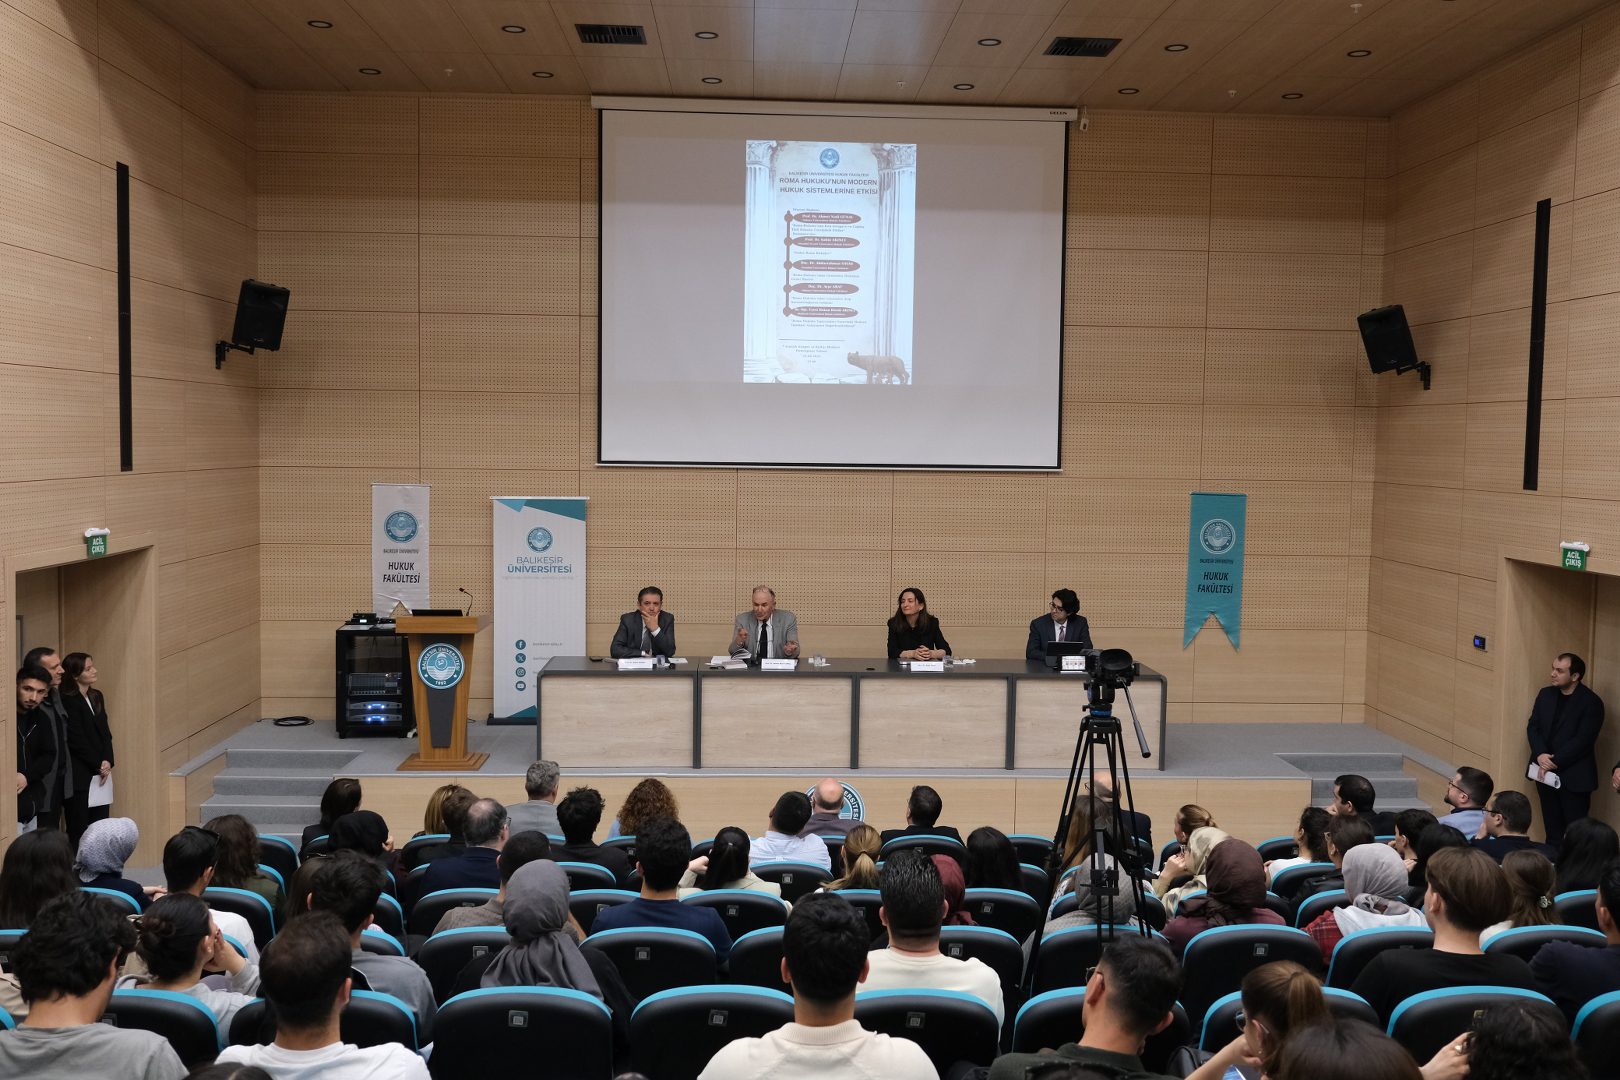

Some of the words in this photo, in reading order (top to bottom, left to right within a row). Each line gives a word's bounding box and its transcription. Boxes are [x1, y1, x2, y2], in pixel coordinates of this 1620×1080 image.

[92, 537, 104, 545] ACİL
[92, 545, 105, 555] ÇIKIŞ
[516, 555, 564, 564] BALIKESİR
[1567, 551, 1581, 559] ACİL
[388, 562, 415, 571] HUKUK
[507, 563, 572, 574] ÜNİVERSİTESİ
[1566, 559, 1582, 569] ÇIKIŞ
[383, 572, 421, 583] FAKÜLTESİ
[1204, 572, 1229, 581] HUKUK
[1198, 583, 1233, 594] FAKÜLTESİ
